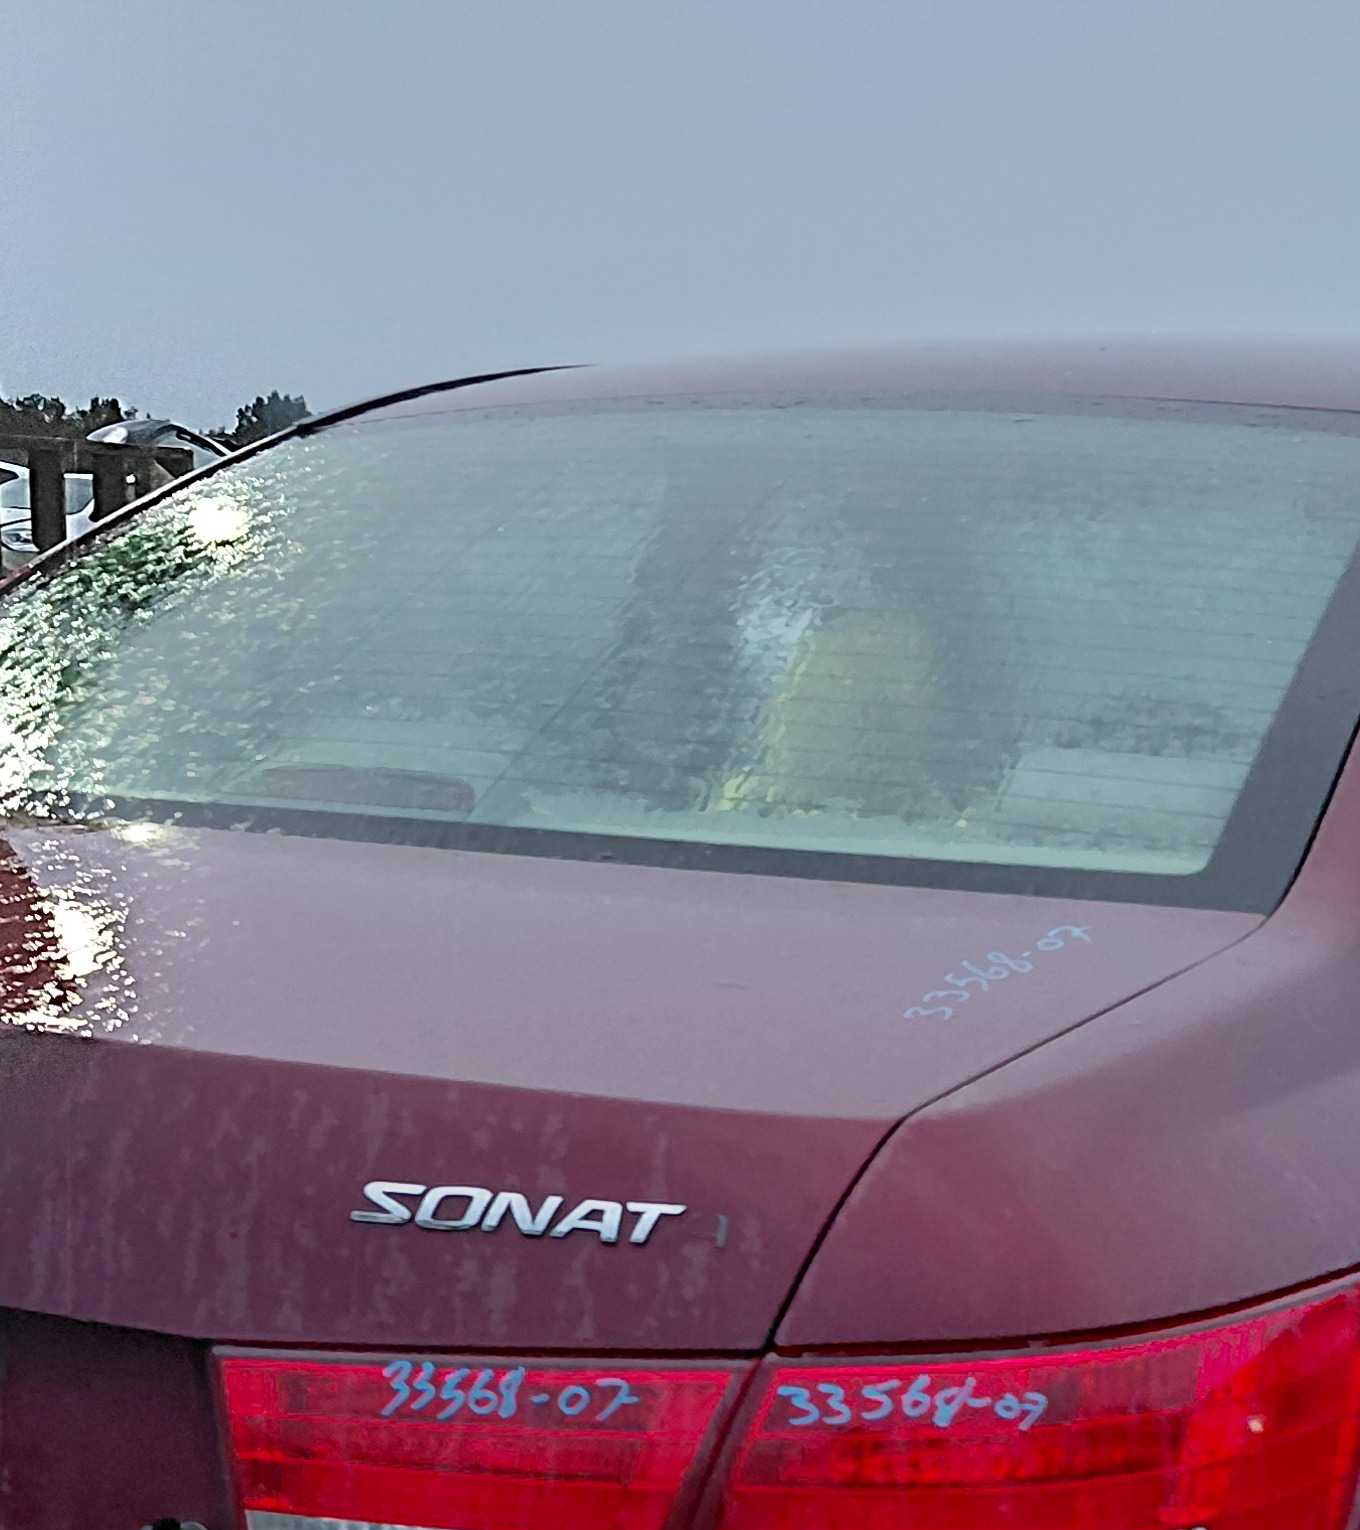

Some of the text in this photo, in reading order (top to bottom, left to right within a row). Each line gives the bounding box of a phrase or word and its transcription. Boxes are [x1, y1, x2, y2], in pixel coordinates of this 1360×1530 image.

[350, 1180, 688, 1244] SONAT
[380, 1360, 640, 1420] 33568-07
[776, 1373, 1048, 1430] 33568-07
